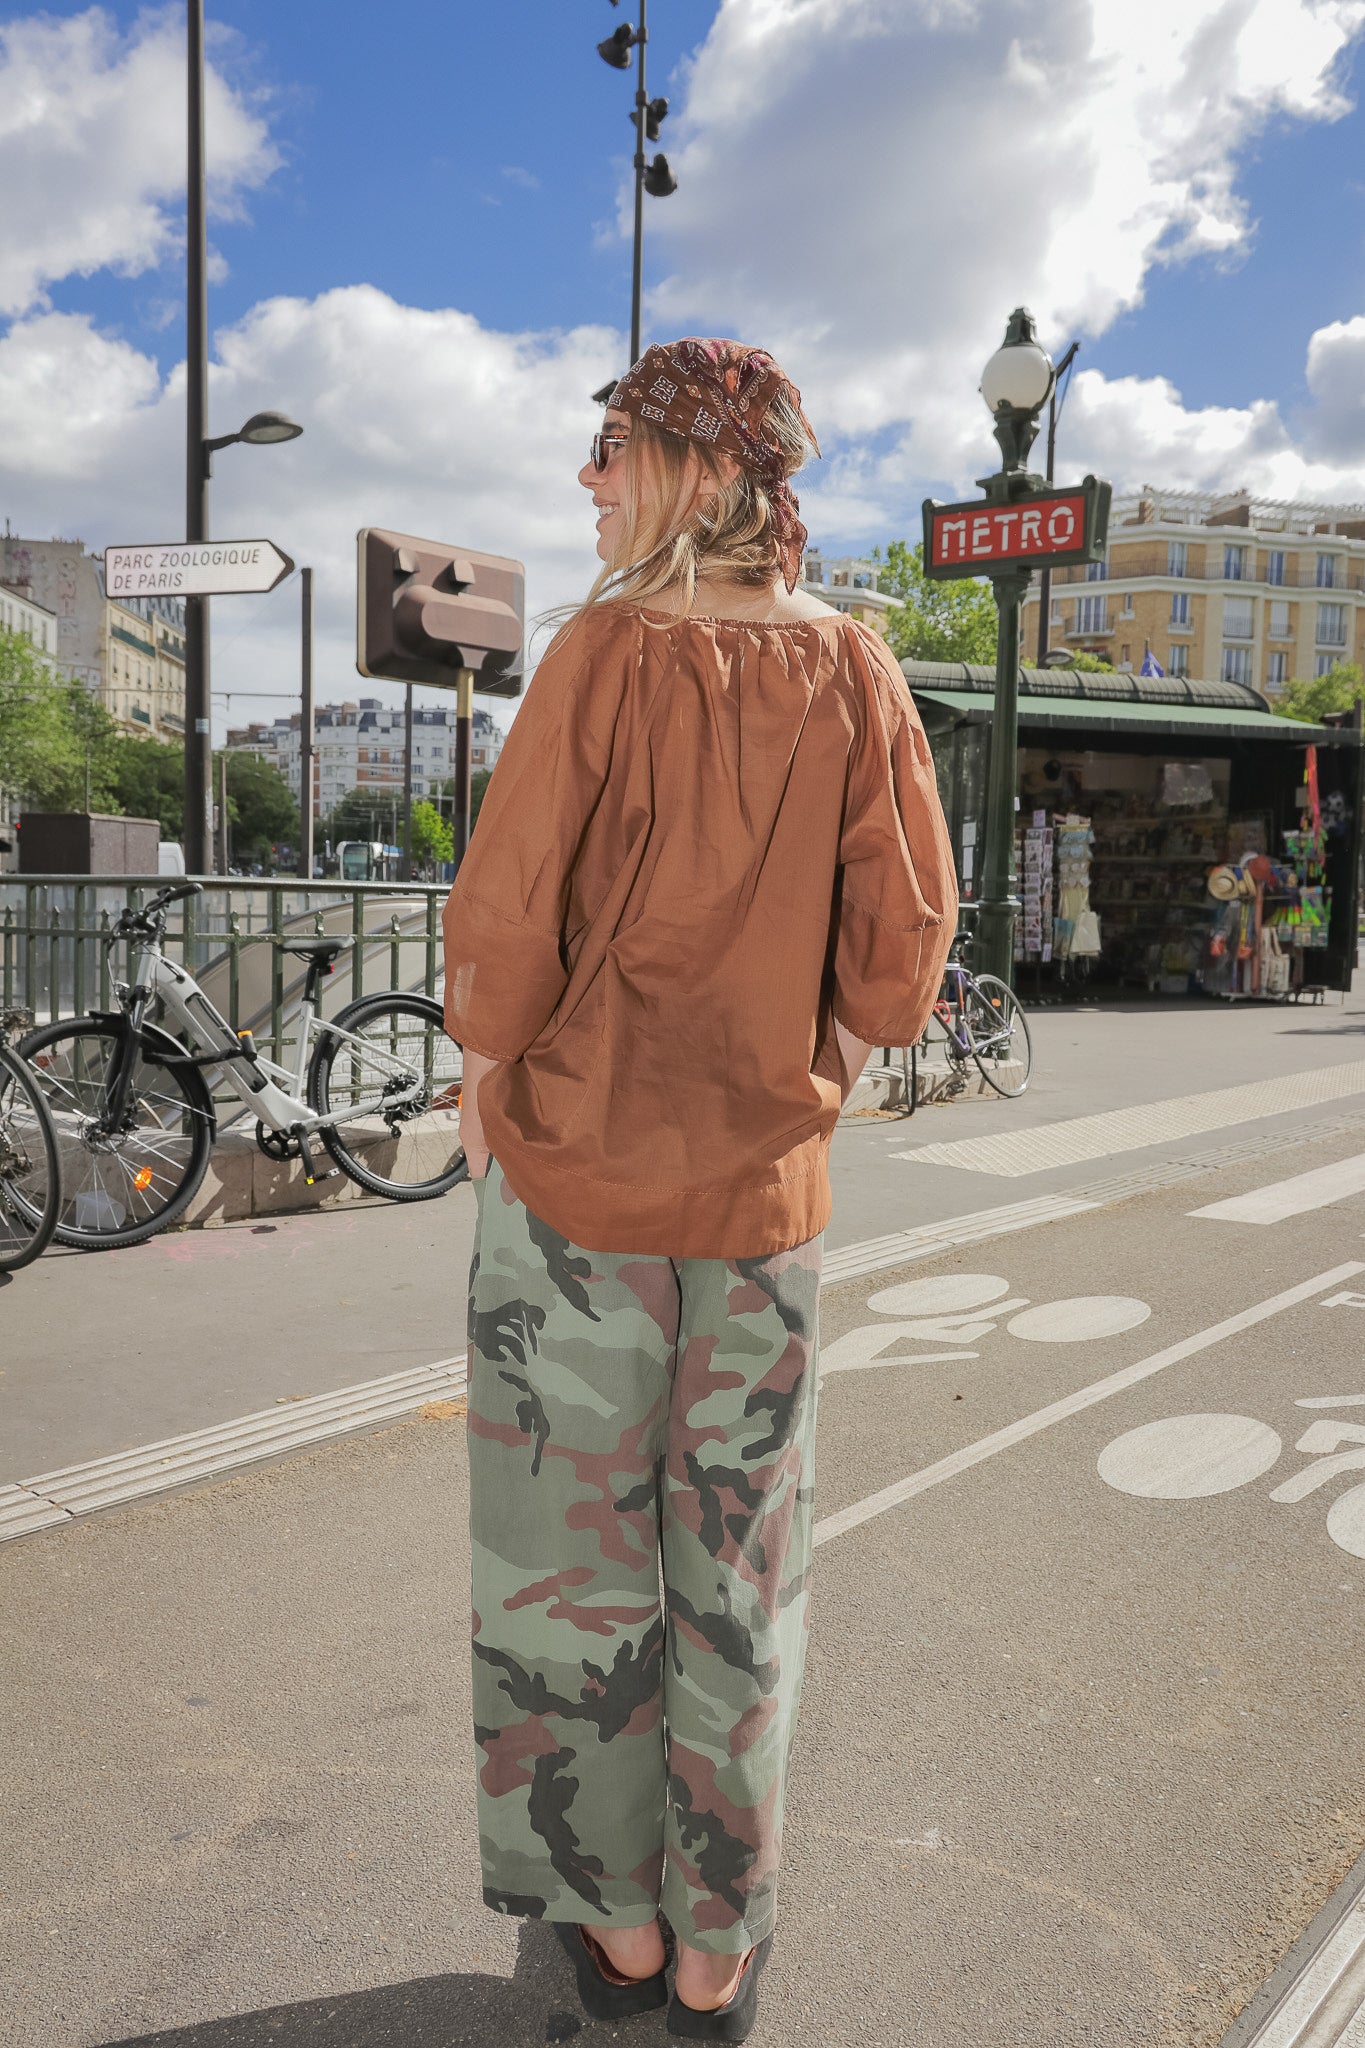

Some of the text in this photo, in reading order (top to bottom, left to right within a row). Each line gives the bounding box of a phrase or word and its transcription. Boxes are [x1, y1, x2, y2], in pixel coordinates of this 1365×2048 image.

[941, 506, 1074, 559] METRO
[112, 549, 260, 570] PARC ZOOLOGIQUE
[114, 572, 183, 589] DE PARIS
